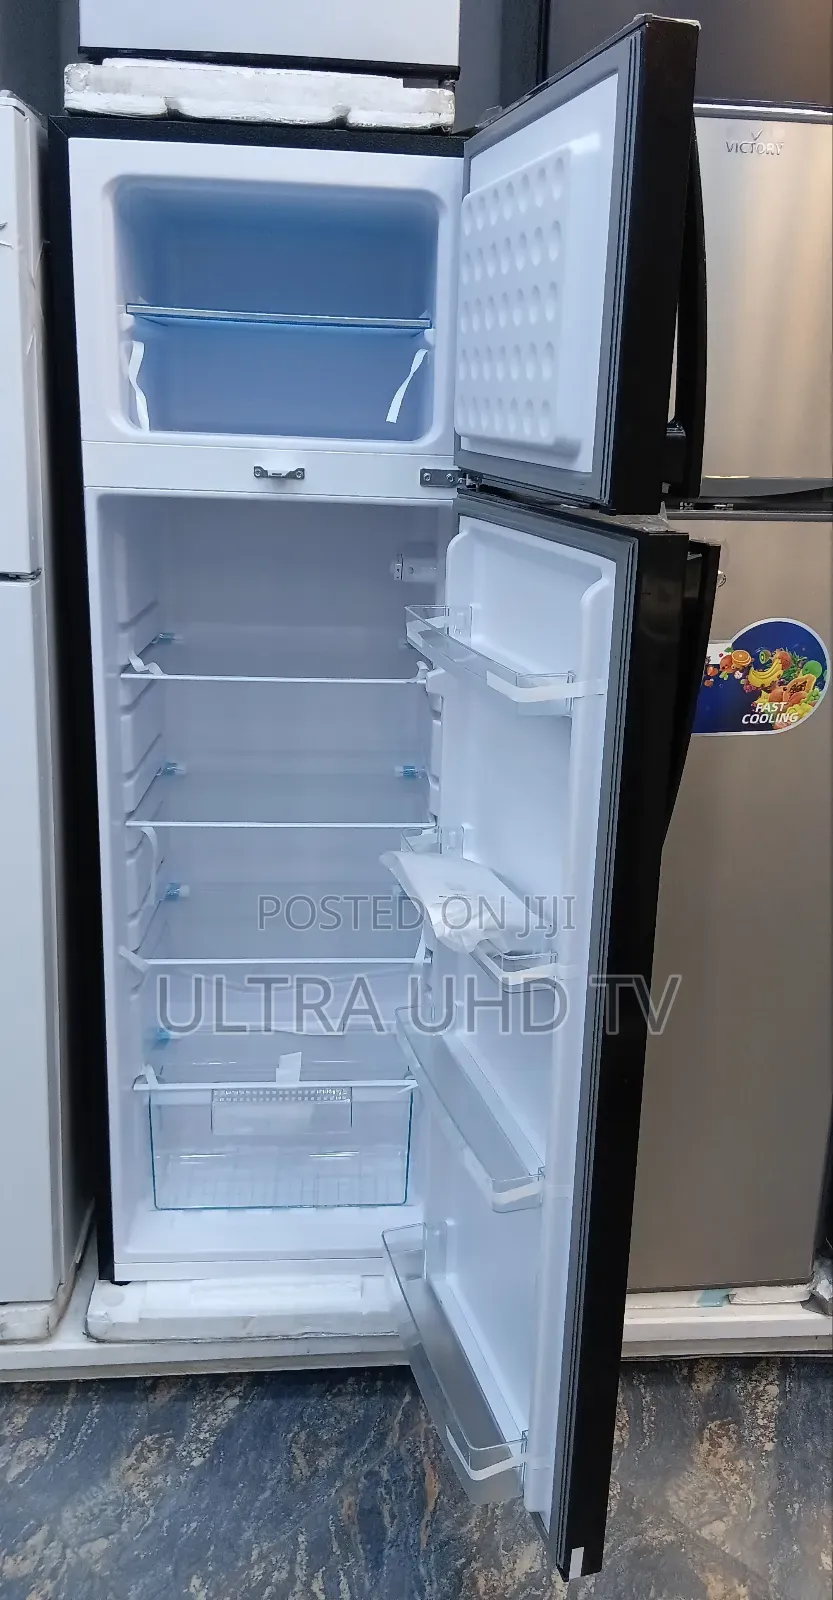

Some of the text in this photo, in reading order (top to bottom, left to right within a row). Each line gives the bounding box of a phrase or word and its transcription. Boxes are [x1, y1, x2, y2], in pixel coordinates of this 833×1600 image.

[725, 141, 784, 155] VICTORY
[755, 702, 787, 713] FAST
[741, 713, 800, 724] COOLING
